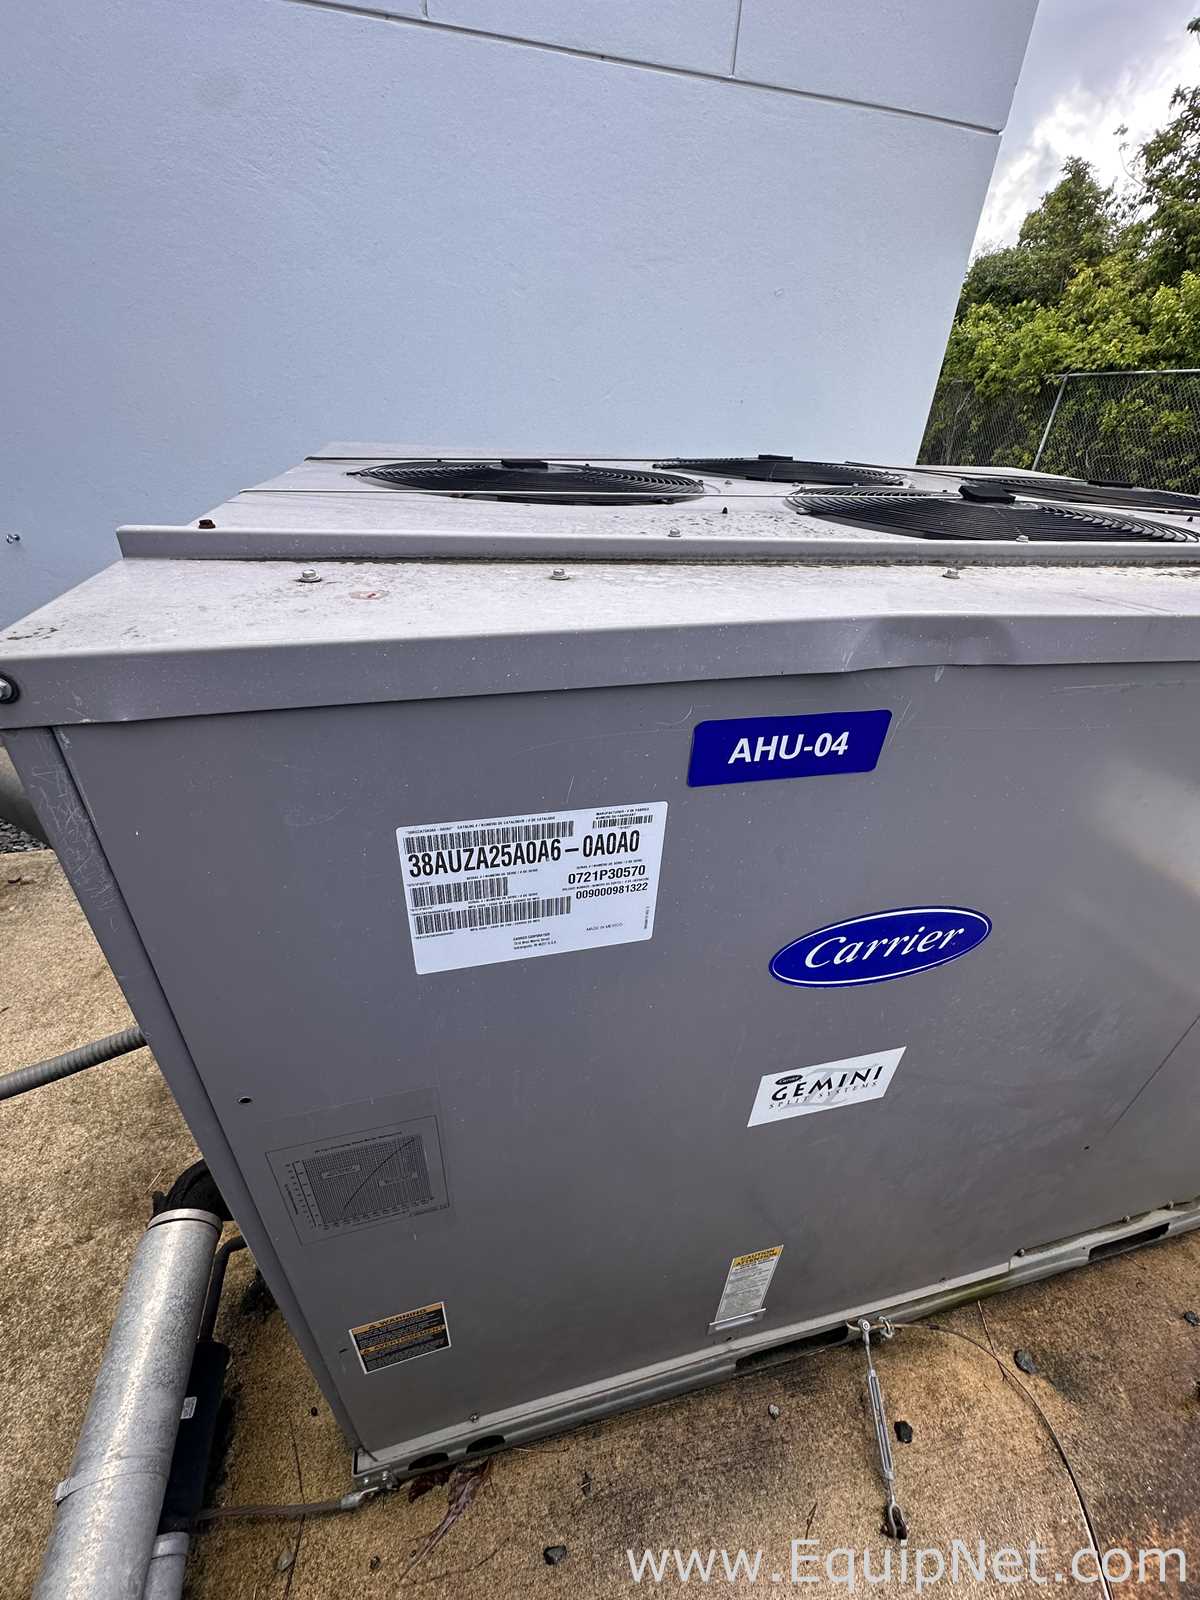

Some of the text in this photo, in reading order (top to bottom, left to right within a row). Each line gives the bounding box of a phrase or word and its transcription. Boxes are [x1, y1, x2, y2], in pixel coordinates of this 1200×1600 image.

[728, 731, 850, 764] AHU-04
[408, 829, 640, 878] 38AUZA25A0A6-0A0A0
[568, 865, 646, 884] 0721P30570
[576, 882, 649, 899] 009000981322
[804, 926, 965, 968] Carrier
[771, 1066, 883, 1101] GEMINI
